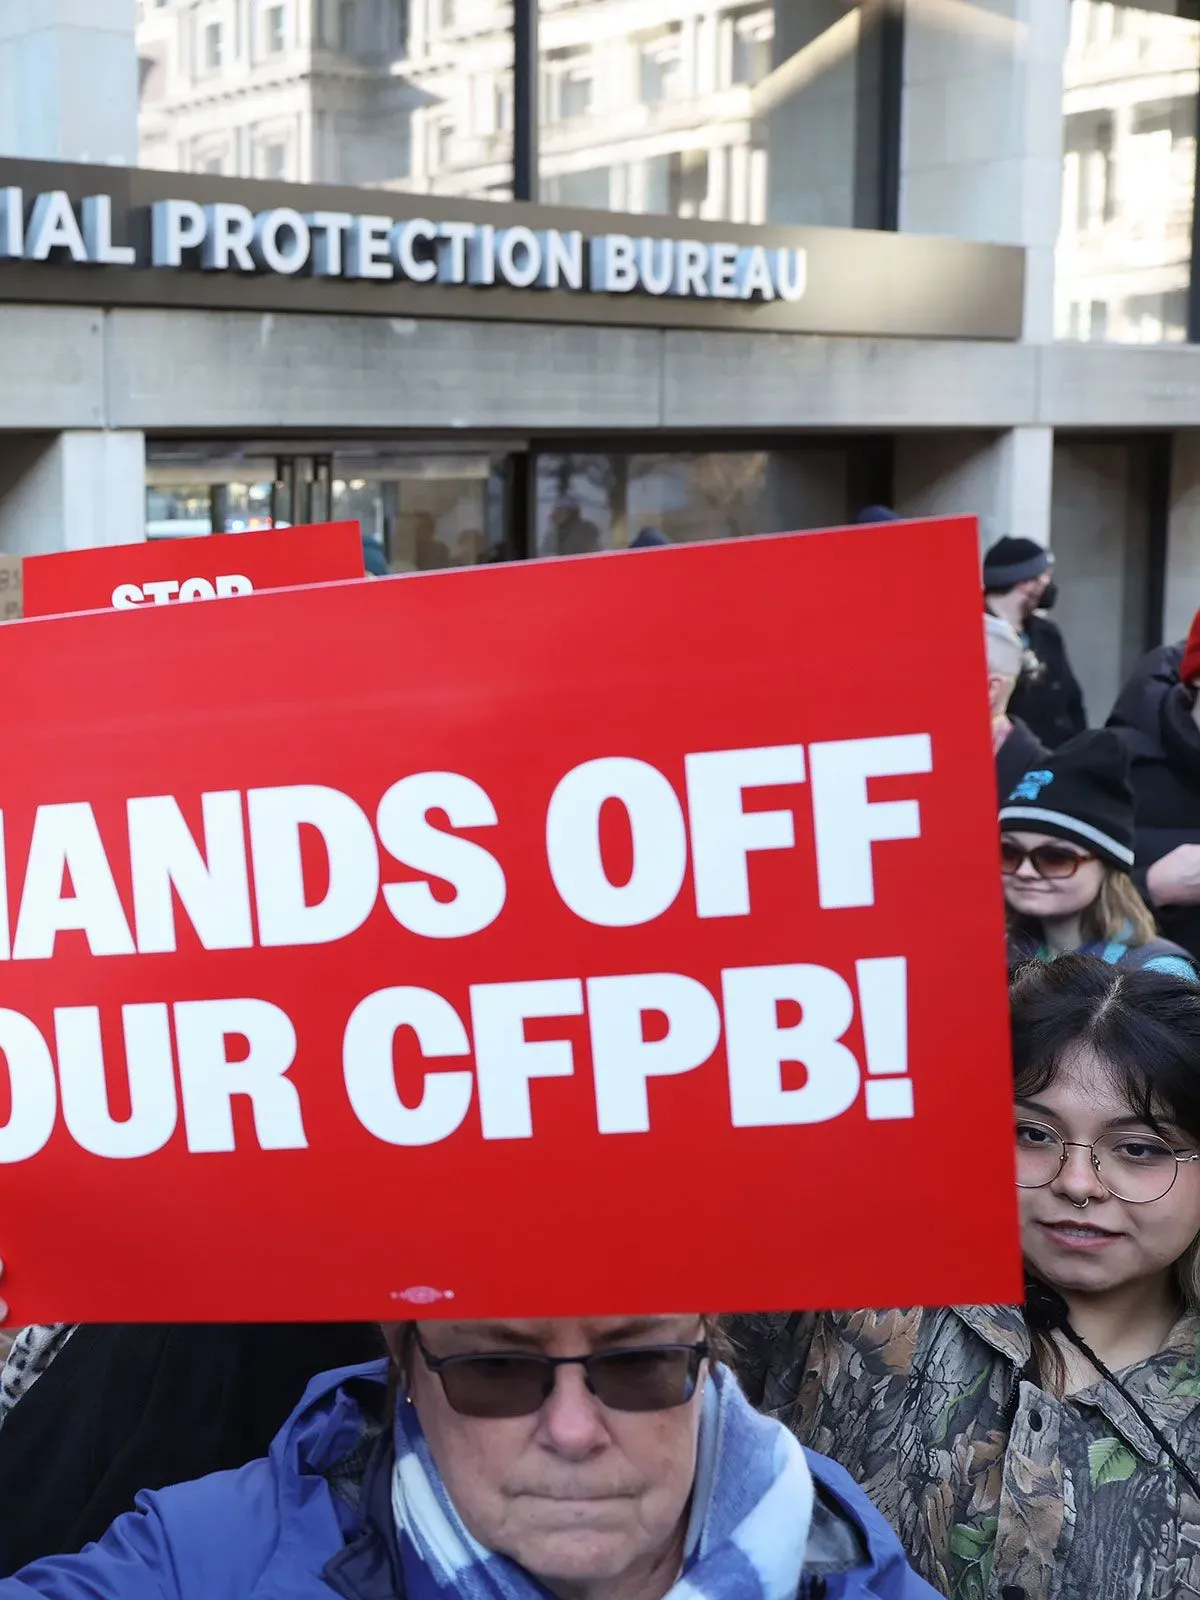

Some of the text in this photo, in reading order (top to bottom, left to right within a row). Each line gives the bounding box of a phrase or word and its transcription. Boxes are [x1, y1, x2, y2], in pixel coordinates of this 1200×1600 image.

[152, 199, 583, 290] PROTECTION
[590, 233, 808, 303] BUREAU
[545, 733, 933, 926] OFF
[342, 956, 914, 1146] CFPB!
